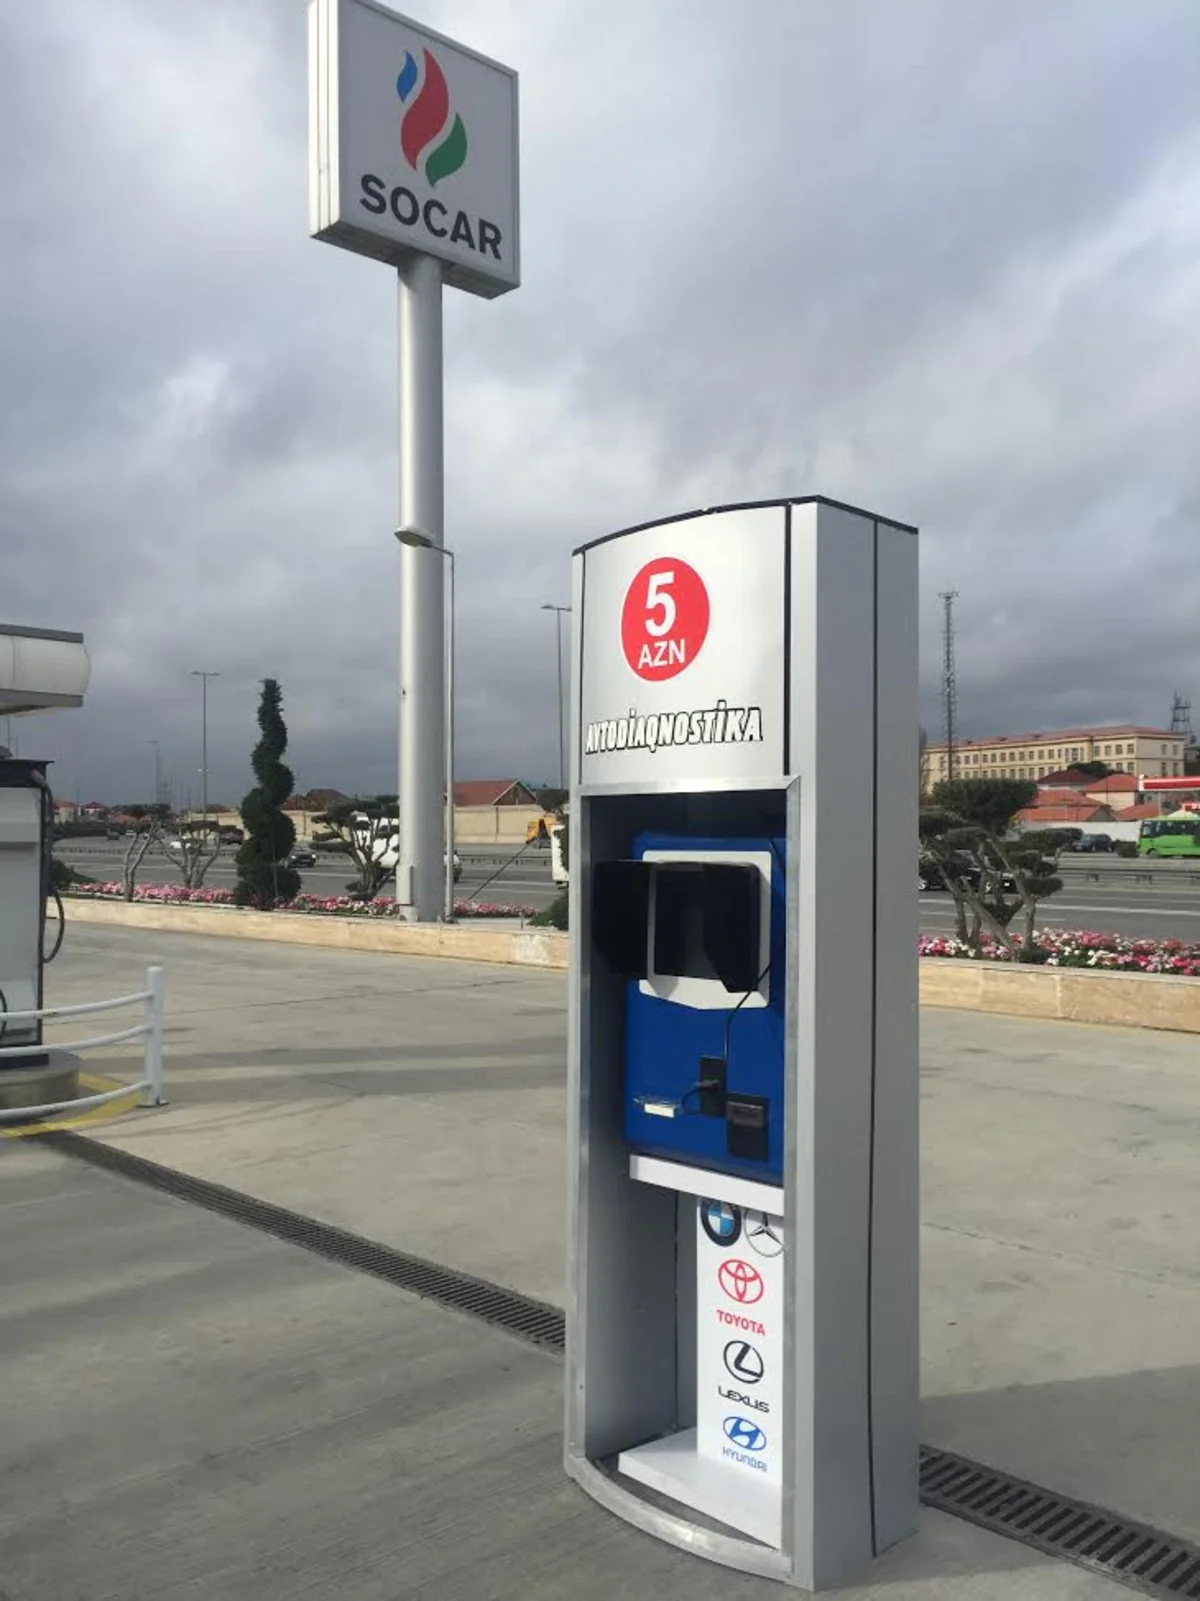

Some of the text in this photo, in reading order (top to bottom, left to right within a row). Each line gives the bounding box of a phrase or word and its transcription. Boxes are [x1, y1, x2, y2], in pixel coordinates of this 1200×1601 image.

[359, 173, 502, 260] SOCAR
[644, 571, 677, 637] 5
[638, 639, 686, 669] AZN
[716, 1309, 766, 1336] TOYOTA
[718, 1386, 769, 1413] LEXUS
[722, 1446, 767, 1472] HYUNDAI
